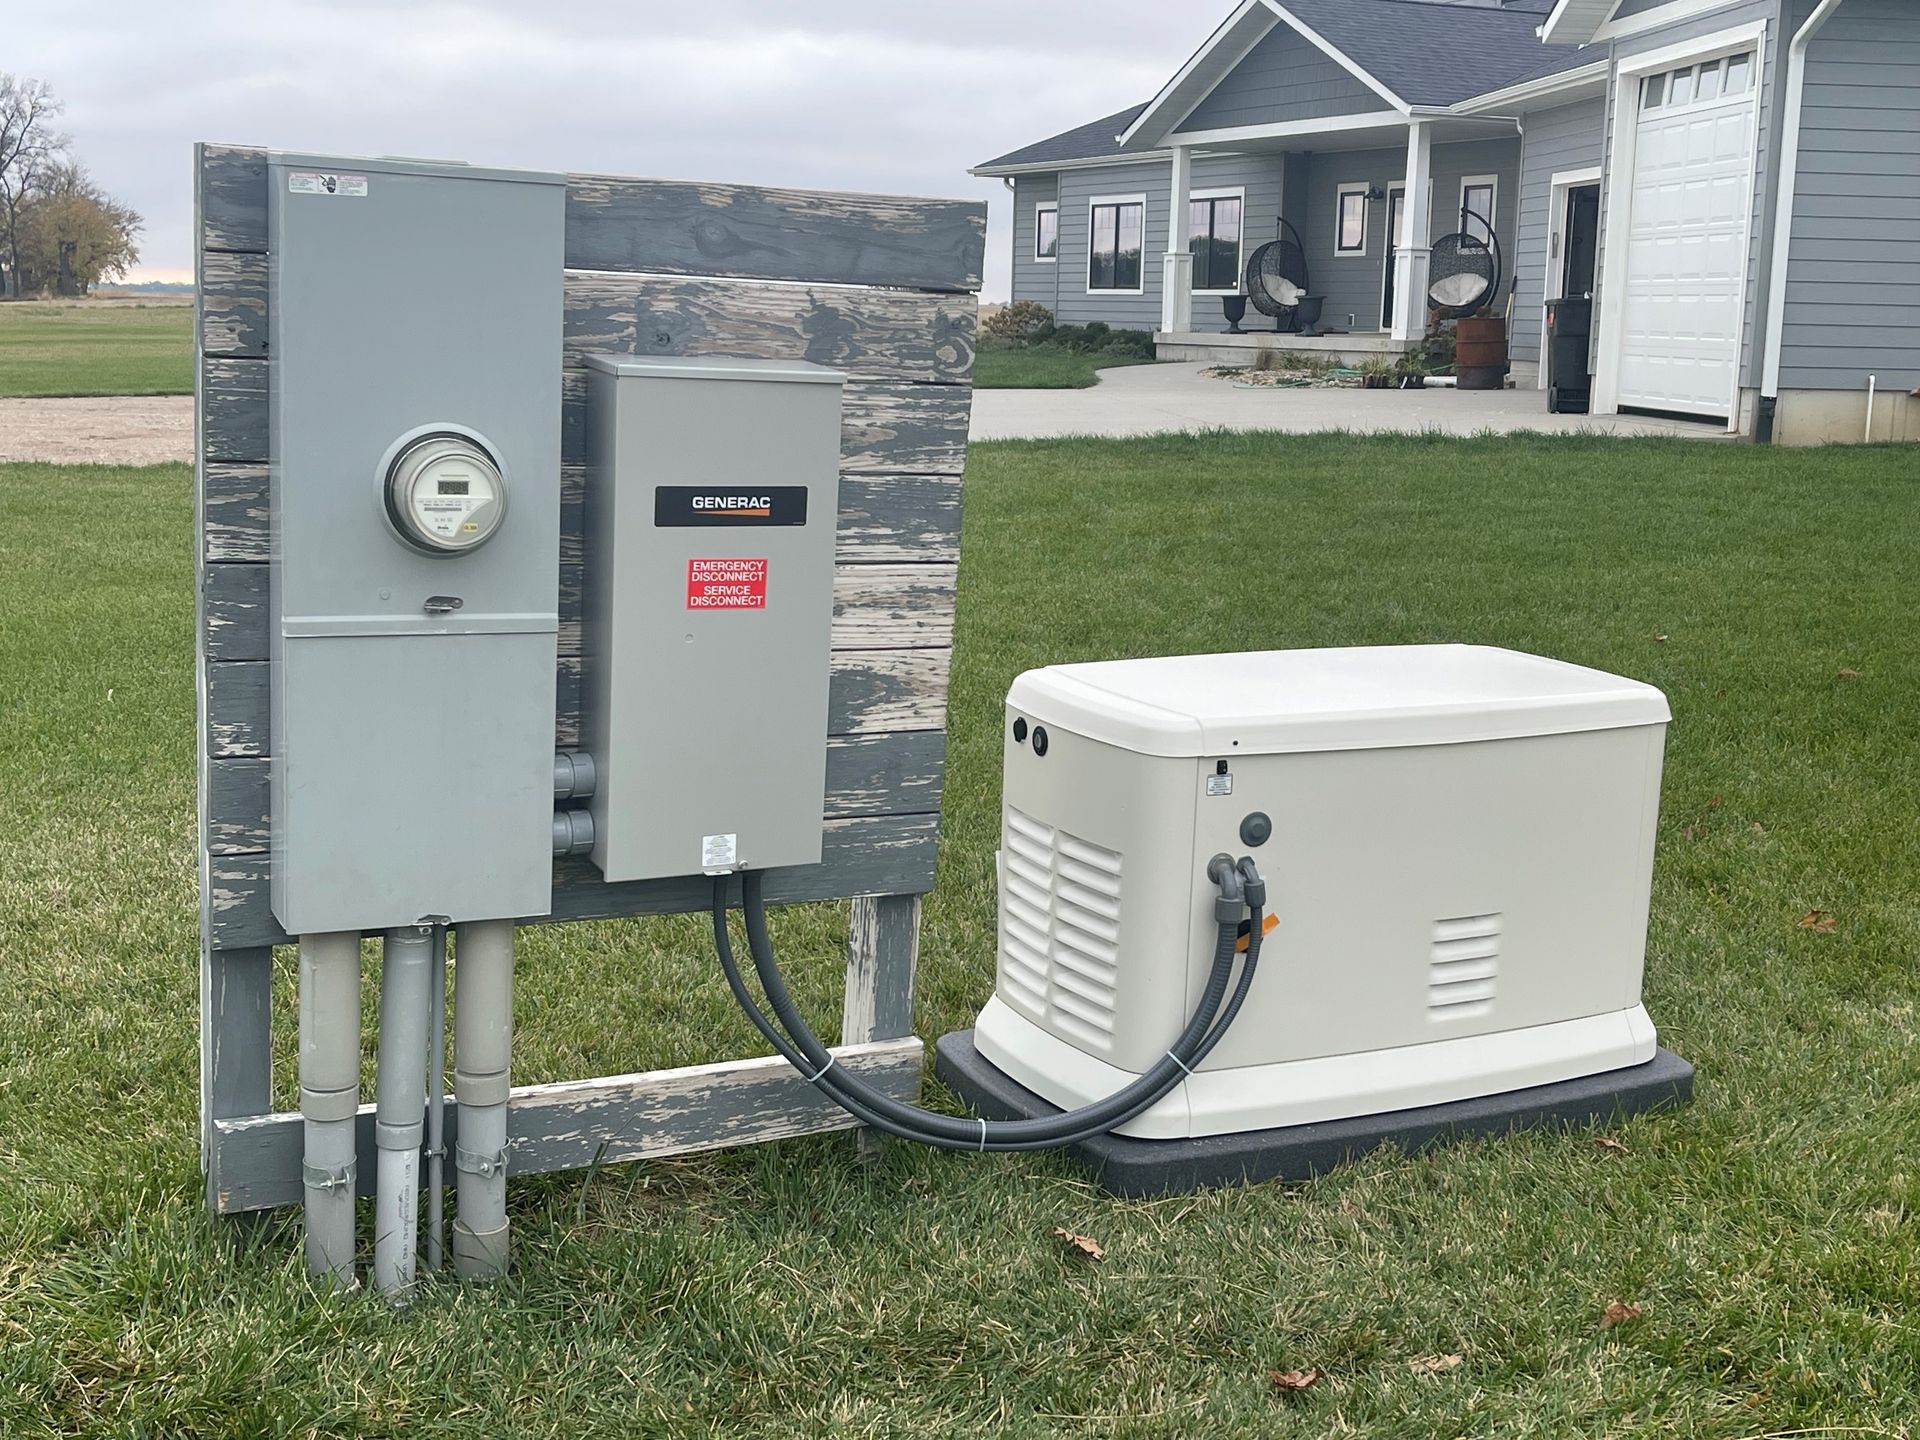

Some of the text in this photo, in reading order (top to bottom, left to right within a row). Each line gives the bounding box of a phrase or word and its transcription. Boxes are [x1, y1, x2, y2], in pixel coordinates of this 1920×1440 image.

[692, 496, 771, 509] GENERAC
[693, 561, 764, 571] EMERGENCY
[691, 571, 764, 582] DISCONNECT
[703, 585, 751, 595] SERVICE
[690, 596, 763, 606] DISCONNECT
